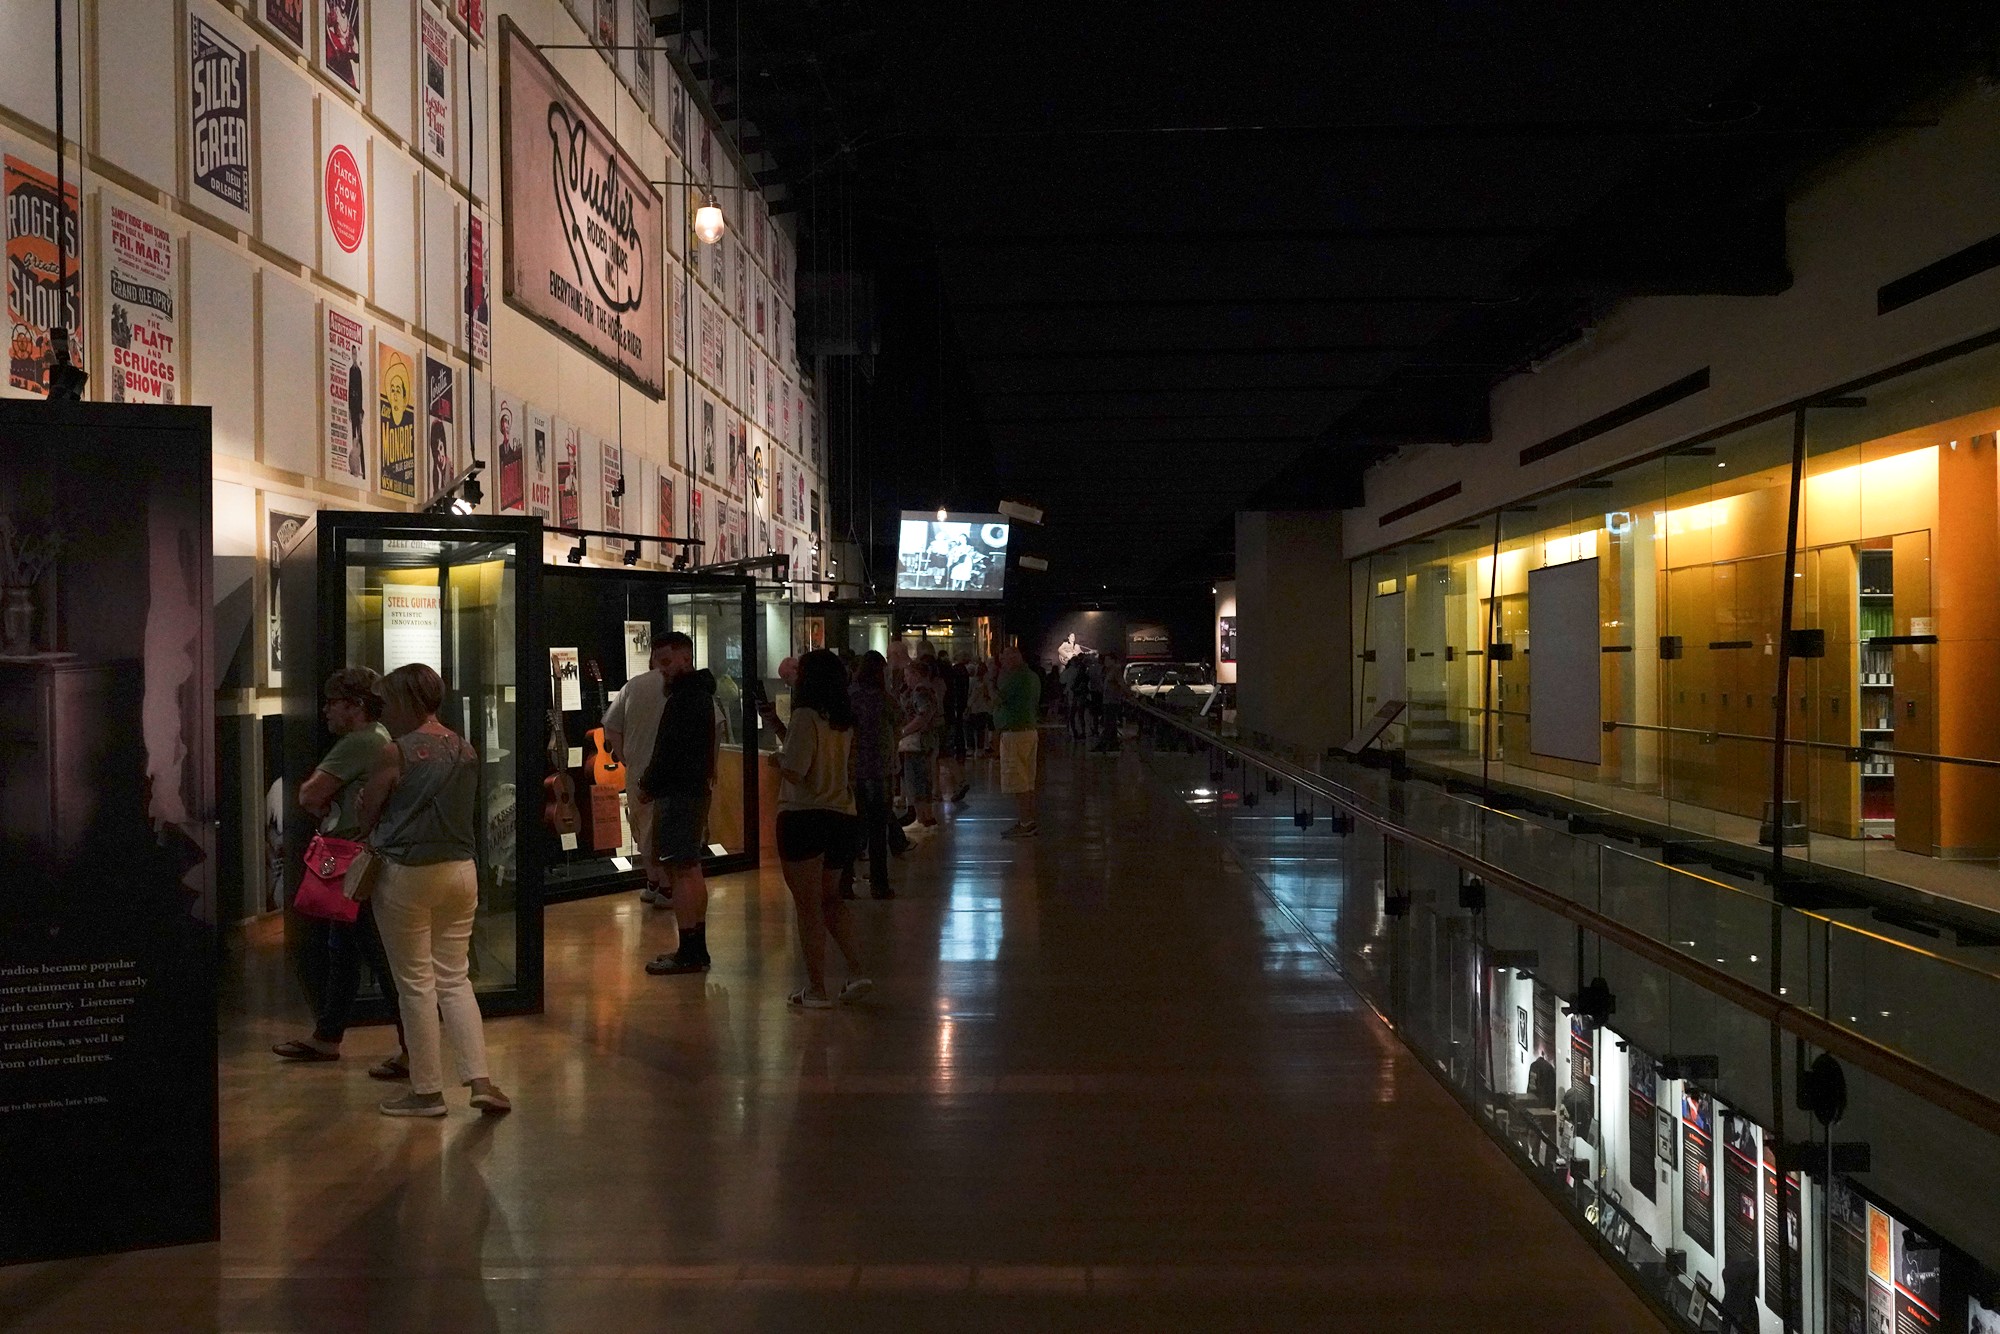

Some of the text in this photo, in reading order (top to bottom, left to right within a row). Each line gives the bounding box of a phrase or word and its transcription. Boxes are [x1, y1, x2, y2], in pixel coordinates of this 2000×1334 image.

[194, 57, 241, 119] SILAS
[195, 116, 248, 178] GREEN
[225, 170, 241, 188] NEW
[548, 101, 635, 250] Nudie's
[210, 177, 242, 204] ORLEANS
[334, 193, 358, 222] PRINT
[586, 215, 608, 255] RODEO
[112, 229, 134, 252] FRI.
[135, 240, 164, 266] MAR.
[164, 253, 171, 269] 7
[113, 279, 173, 314] GRAND OLE OPRY
[549, 269, 583, 318] EVERYTHING
[584, 295, 594, 326] FOR
[596, 304, 607, 334] THE
[147, 319, 161, 331] THE
[133, 324, 174, 354] FLATT
[114, 346, 175, 382] SCRUGGS
[147, 349, 162, 359] AND
[125, 370, 162, 398] SHOW
[330, 383, 348, 402] CASH
[382, 420, 414, 468] MONROE
[532, 482, 550, 506] ACUFF
[387, 596, 437, 609] STEEL GUITAR
[1, 959, 136, 976] radios became popular
[0, 976, 148, 995] ntertainment in the early
[27, 1001, 75, 1012] century.
[80, 996, 135, 1008] Listeners
[11, 1021, 44, 1031] tunes
[47, 1018, 71, 1029] that
[73, 1014, 124, 1027] reflected
[4, 1033, 125, 1051] traditions, as well as
[0, 1054, 113, 1069] rom other cultures.
[22, 1102, 37, 1110] the
